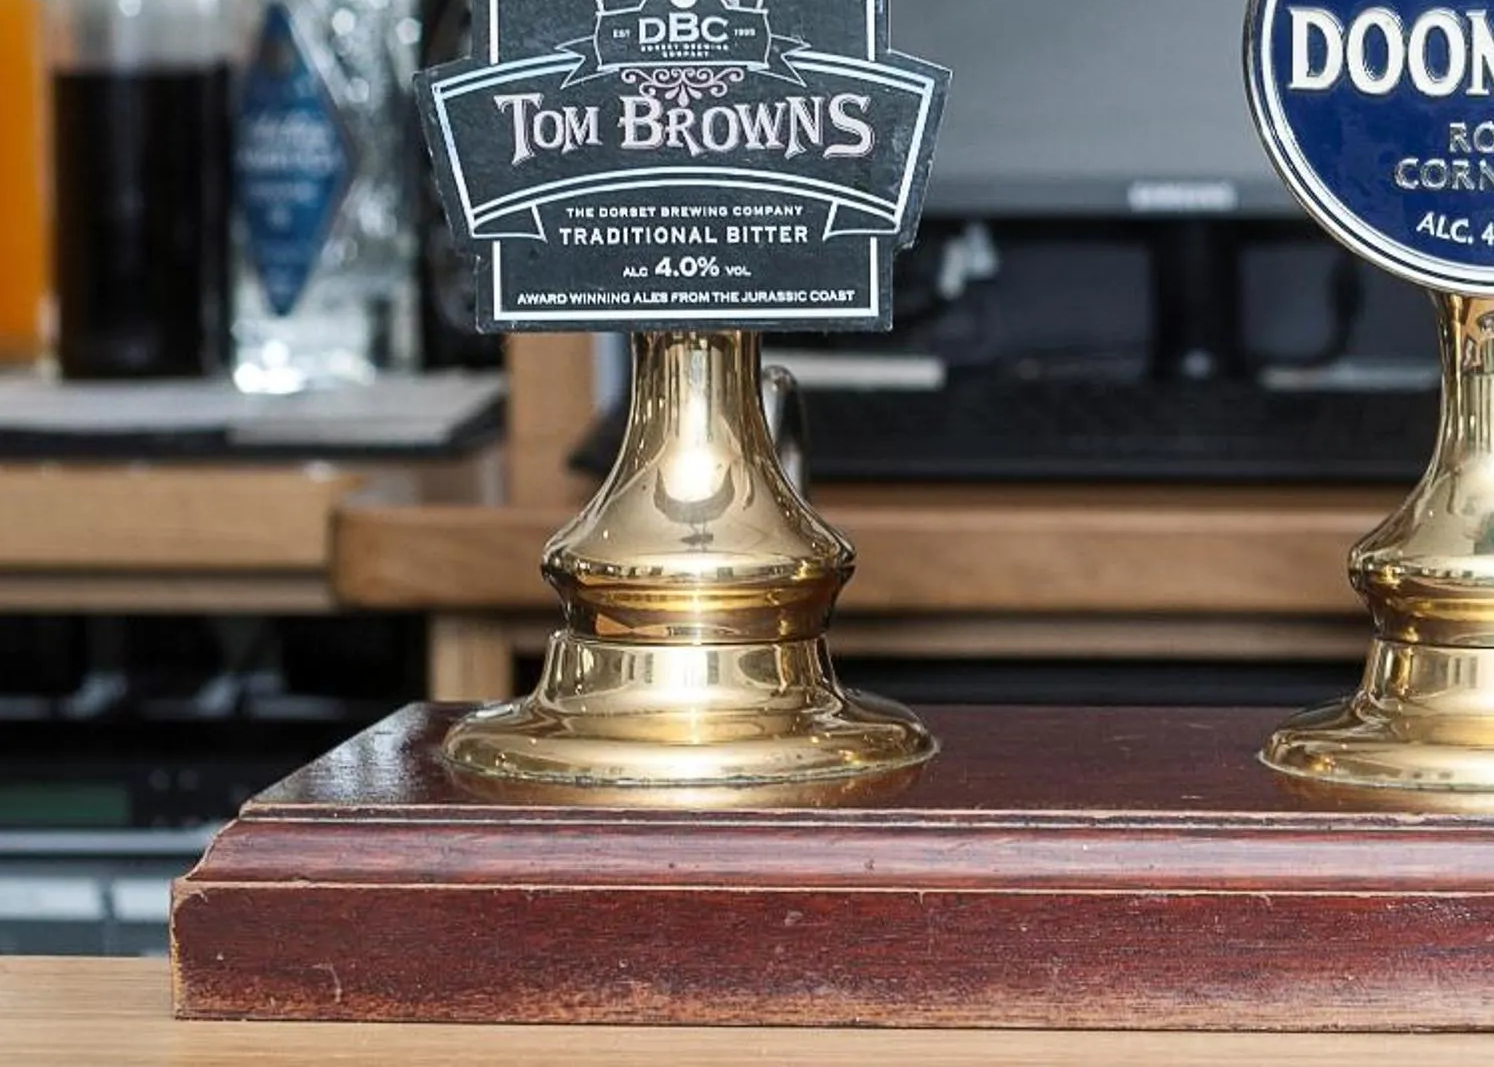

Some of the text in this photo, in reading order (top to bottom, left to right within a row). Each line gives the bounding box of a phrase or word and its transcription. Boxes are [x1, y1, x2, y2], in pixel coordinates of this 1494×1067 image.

[638, 12, 729, 45] DBC
[566, 205, 804, 218] THE DORSET BREWING COMPANY
[559, 225, 809, 245] TRADITIONAL BITTER
[1416, 210, 1474, 245] ALC.
[623, 256, 752, 278] ALC 4.0% VOL
[517, 290, 856, 305] AWARD WINNING ALES FROM THE JURASSIC COAST
